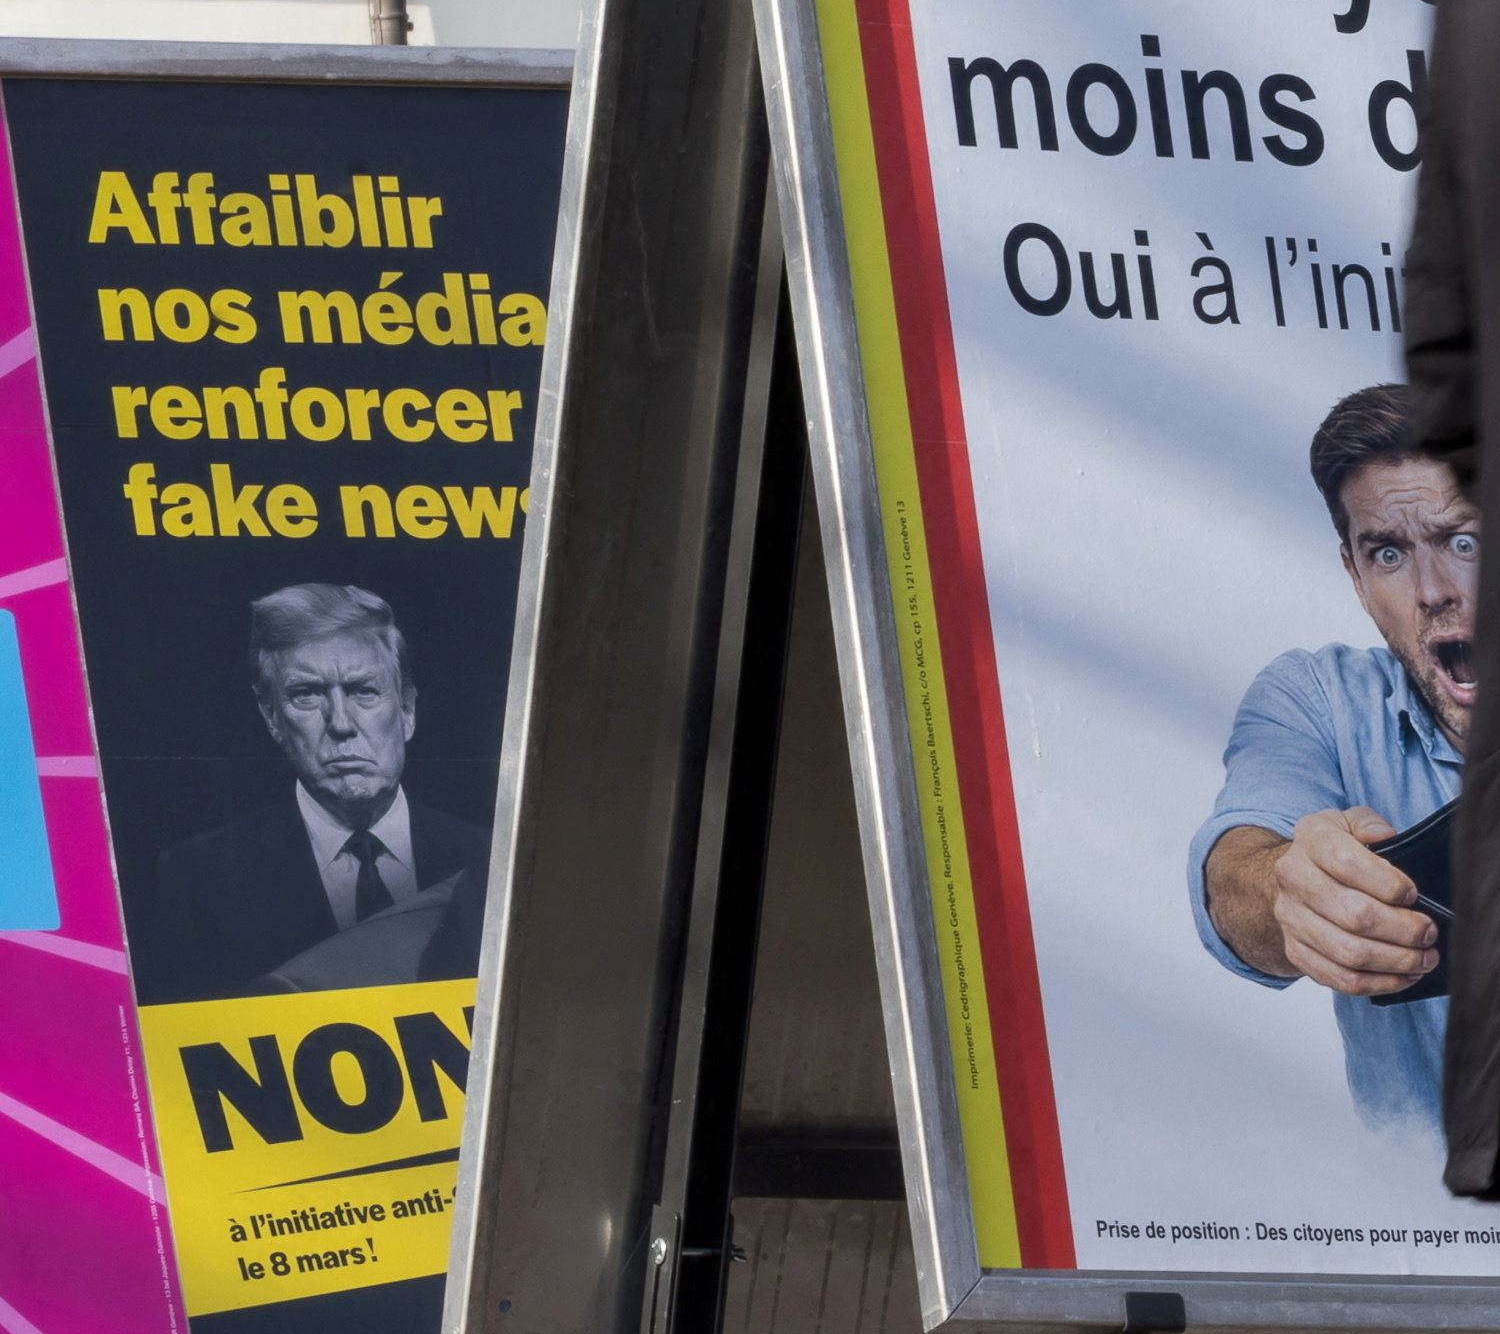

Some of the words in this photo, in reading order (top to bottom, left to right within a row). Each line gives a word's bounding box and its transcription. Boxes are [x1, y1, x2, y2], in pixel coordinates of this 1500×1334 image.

[947, 35, 1325, 167] moins
[88, 171, 443, 249] Affaiblir
[1002, 223, 1159, 322] Oui
[1190, 233, 1240, 325] à
[1265, 236, 1405, 333] l'ini
[98, 288, 258, 344] nos
[111, 368, 523, 442] renforcer
[122, 463, 319, 539] fake
[339, 482, 530, 539] new
[228, 1217, 248, 1243] à
[250, 1202, 385, 1239] l'initiative
[1096, 1219, 1141, 1240] Prise
[1145, 1221, 1166, 1240] de
[1171, 1221, 1241, 1245] position
[1255, 1222, 1289, 1242] Des
[1293, 1223, 1364, 1246] citoyens
[1369, 1229, 1407, 1247] pour
[1413, 1228, 1459, 1248] payer
[238, 1257, 265, 1281] le
[269, 1251, 291, 1277] 8
